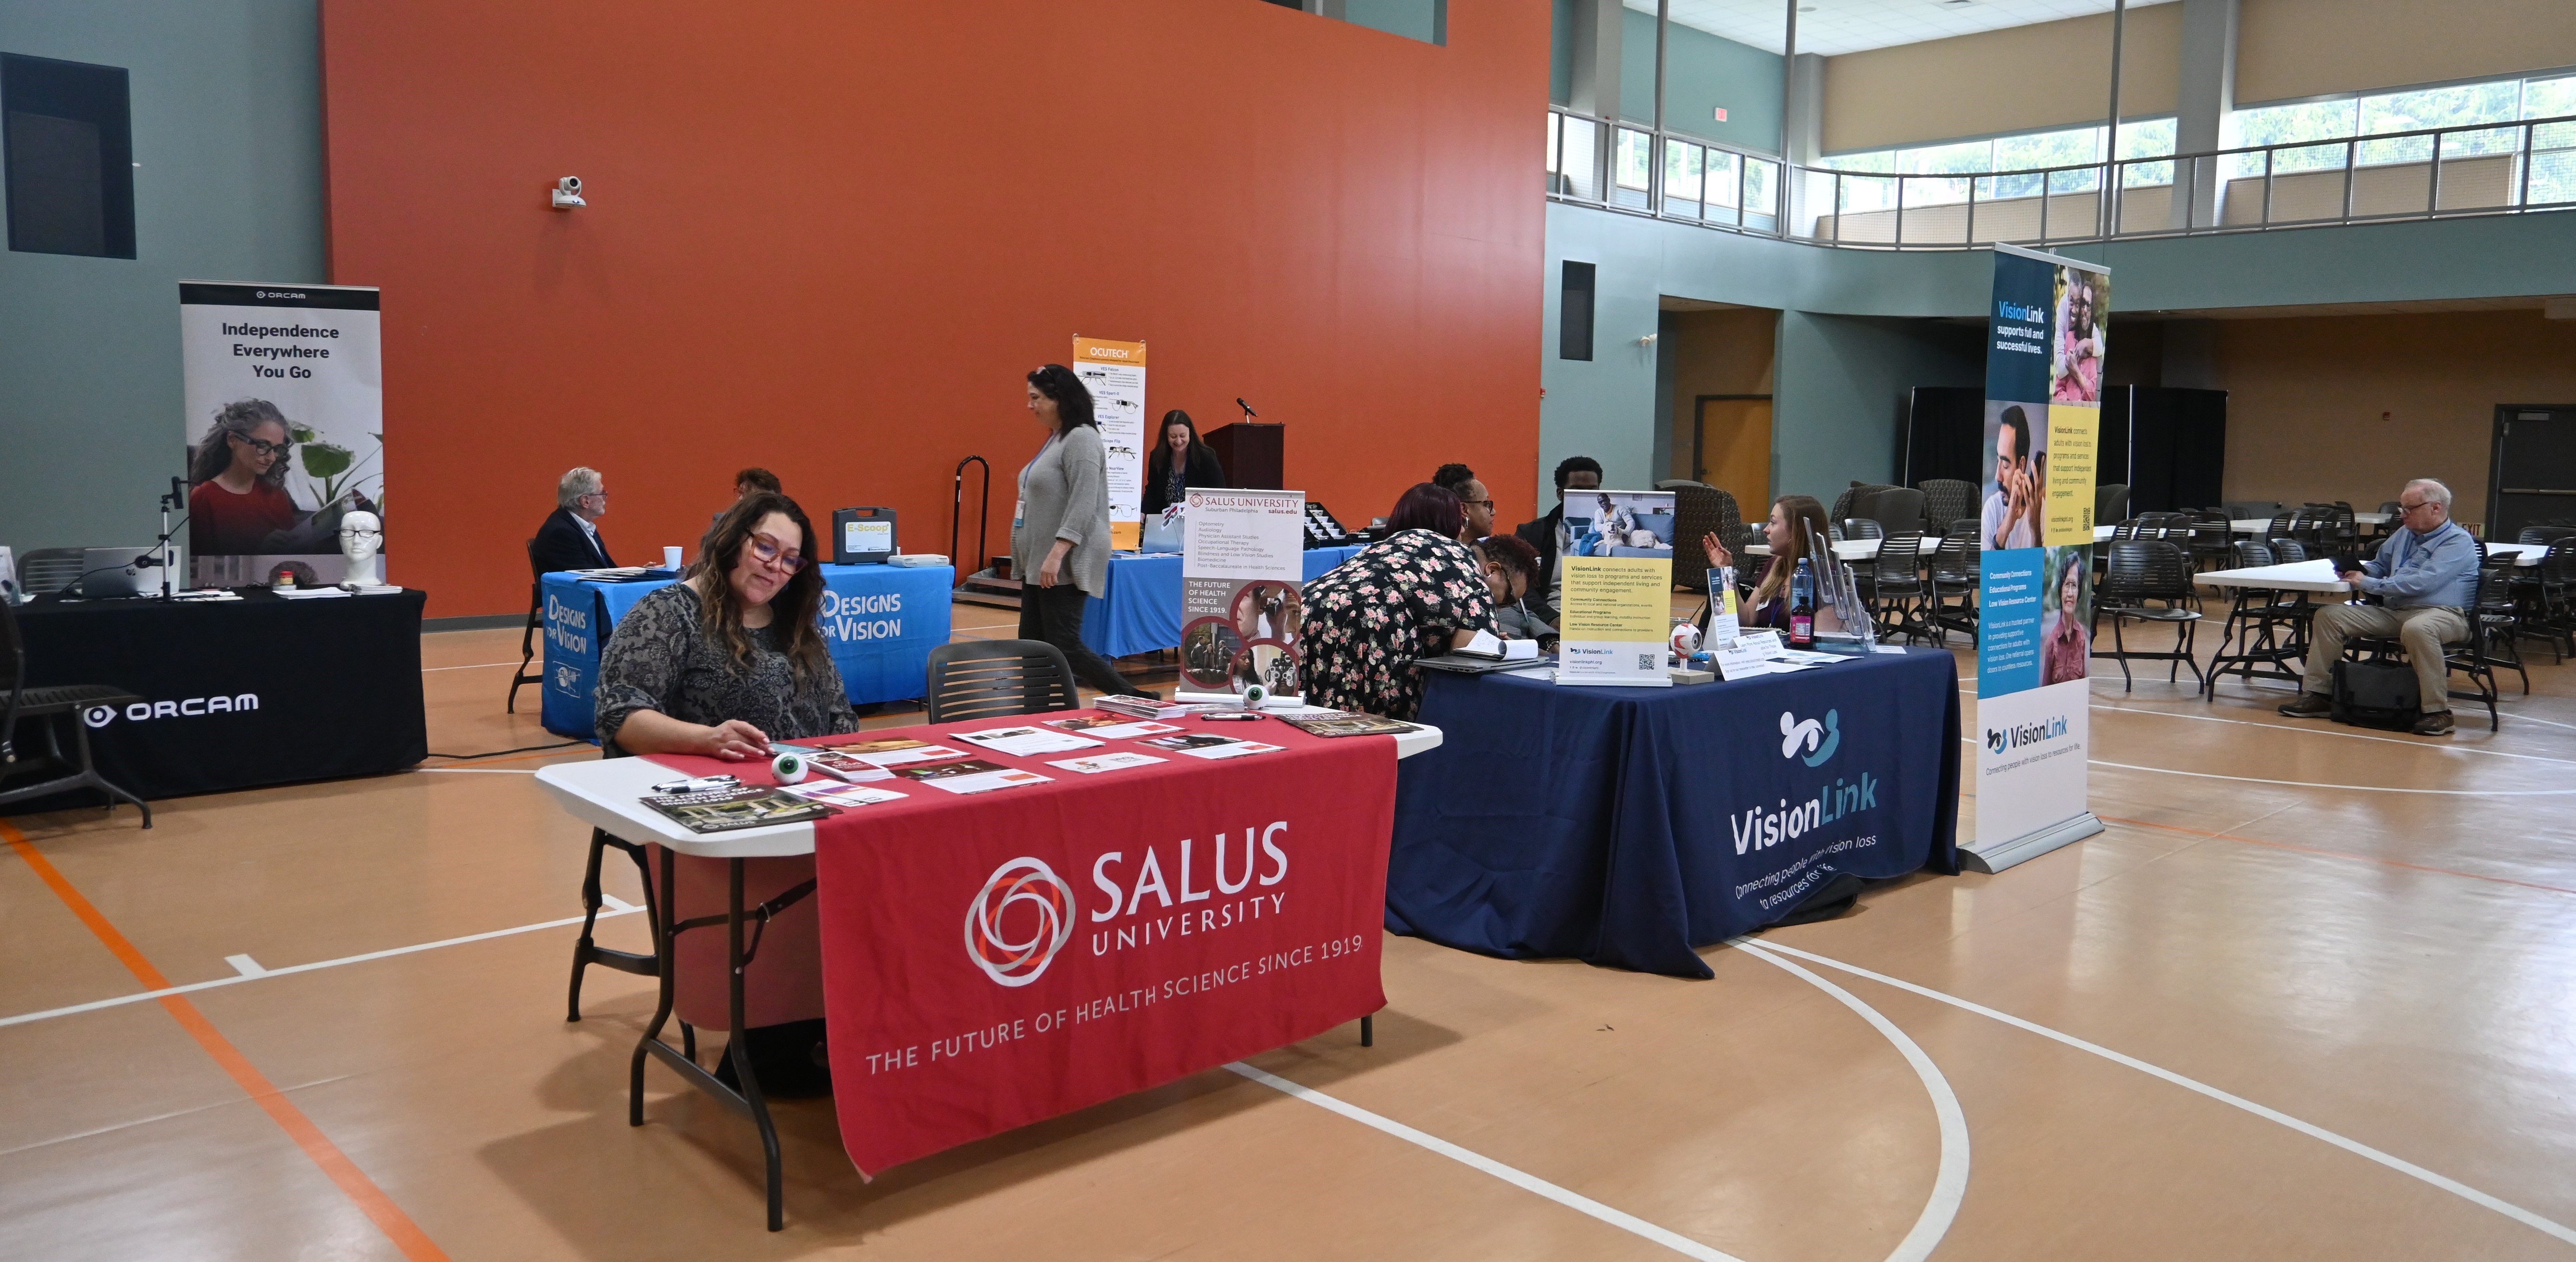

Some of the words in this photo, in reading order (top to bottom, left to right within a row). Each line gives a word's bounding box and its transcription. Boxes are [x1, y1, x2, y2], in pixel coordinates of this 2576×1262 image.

[1999, 301, 2044, 324] VisionLink
[222, 322, 339, 339] Independence
[1997, 325, 2024, 338] supports
[2032, 329, 2044, 340] and
[233, 344, 329, 360] Everywhere
[1090, 347, 1128, 359] OCUTECH
[1997, 340, 2027, 352] successful
[2028, 342, 2042, 354] lives.
[252, 365, 284, 378] You
[289, 366, 311, 378] Go
[2054, 426, 2073, 434] VisionLink
[1205, 496, 1235, 506] SALUS
[1238, 498, 1298, 508] UNIVERSITY
[2462, 524, 2481, 536] EXIT
[1989, 570, 2011, 580] Community
[2010, 569, 2032, 577] Connections
[1989, 585, 2010, 594] Educational
[549, 594, 586, 629] DESIGNS
[819, 590, 901, 618] DESIGNS
[557, 620, 586, 654] VISION
[818, 625, 836, 637] OR
[835, 615, 900, 642] VISION
[126, 693, 259, 721] ORCAM
[2011, 715, 2067, 748] VisionLink
[1986, 764, 2006, 775] Connecting
[2007, 760, 2021, 771] people
[2029, 755, 2040, 763] vision
[2052, 747, 2068, 756] resources
[1731, 772, 1877, 855] VisionLink
[1092, 821, 1287, 922] SALUS
[1736, 871, 1780, 900] Connecting
[1781, 857, 1807, 883] people
[1856, 835, 1876, 848] loss
[1760, 898, 1769, 910] to
[1769, 878, 1810, 906] resources
[1806, 869, 1822, 882] for
[1093, 892, 1285, 956] UNIVERSITY
[865, 1045, 918, 1075] THE
[931, 1019, 1024, 1061] FUTURE
[1035, 1009, 1067, 1033] OF
[1076, 985, 1156, 1024] HEALTH
[1163, 961, 1250, 999] SCIENCE
[1258, 946, 1313, 975] SINCE
